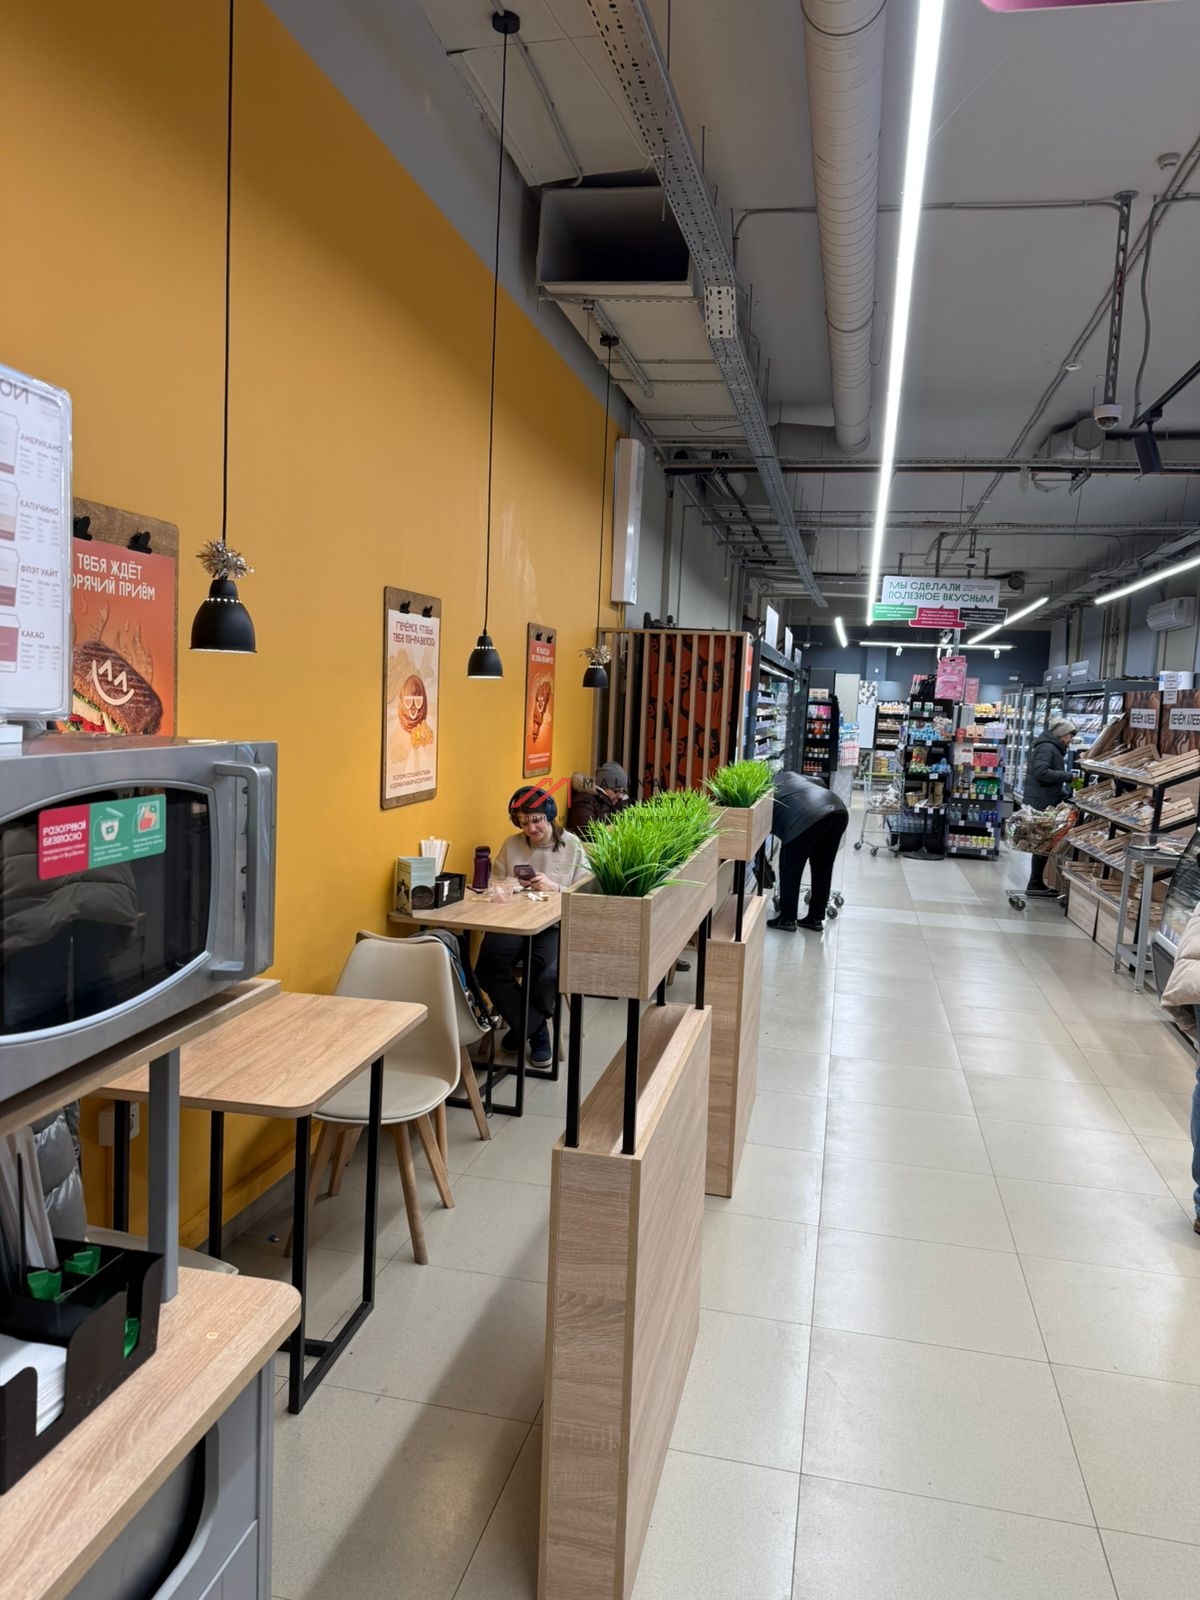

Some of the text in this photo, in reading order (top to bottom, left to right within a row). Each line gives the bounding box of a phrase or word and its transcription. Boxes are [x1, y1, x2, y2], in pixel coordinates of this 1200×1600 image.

[20, 433, 63, 453] АМЕРИКАНО
[20, 499, 60, 516] КАПУЧИНО
[110, 559, 143, 580] ЖДЁТ
[889, 581, 908, 590] МЫ
[888, 590, 994, 604] ПОЛЕЗНОЕ ВКУСНЫМ
[21, 630, 45, 639] КАКАО
